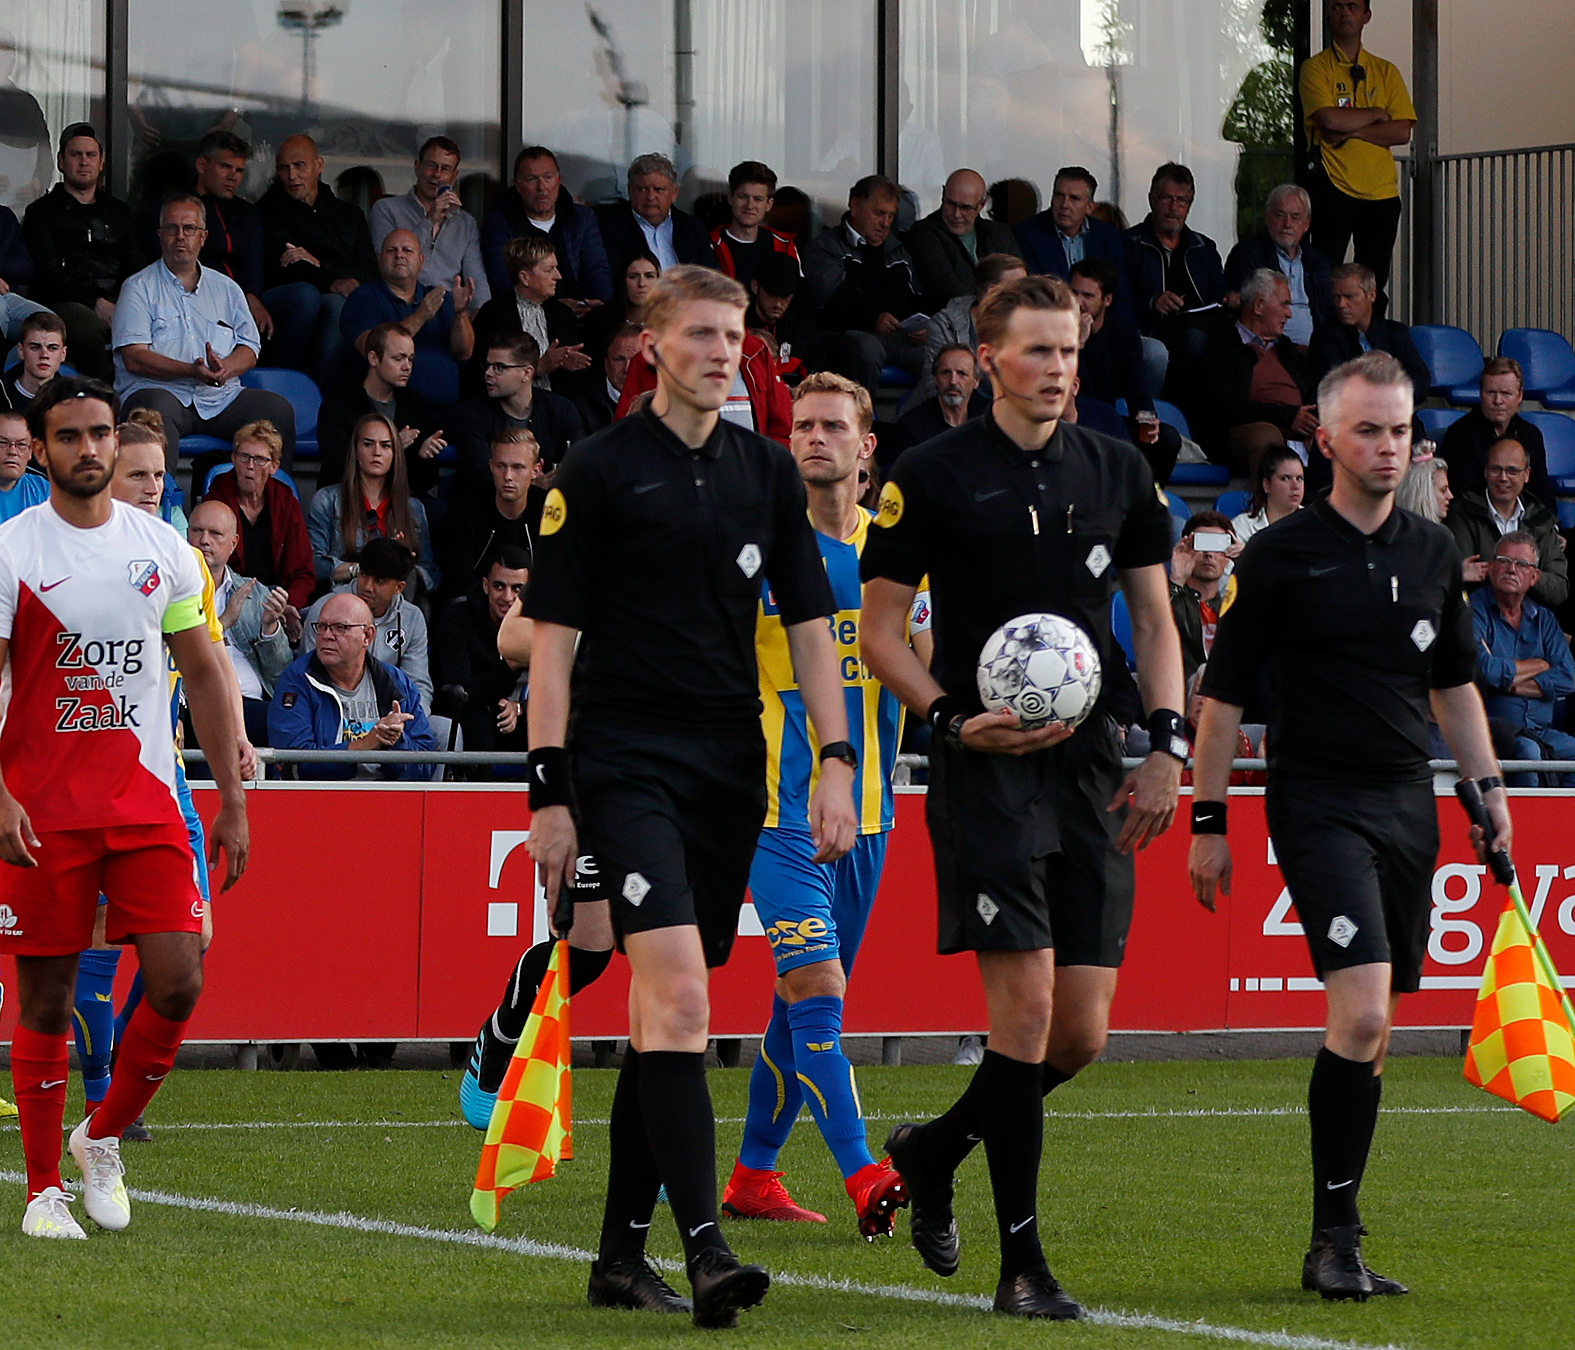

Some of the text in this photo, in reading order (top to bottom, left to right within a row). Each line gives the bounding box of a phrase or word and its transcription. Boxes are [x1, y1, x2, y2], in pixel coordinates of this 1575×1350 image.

[56, 632, 144, 675] Zorg
[65, 671, 124, 690] van de
[55, 695, 140, 732] Zaak
